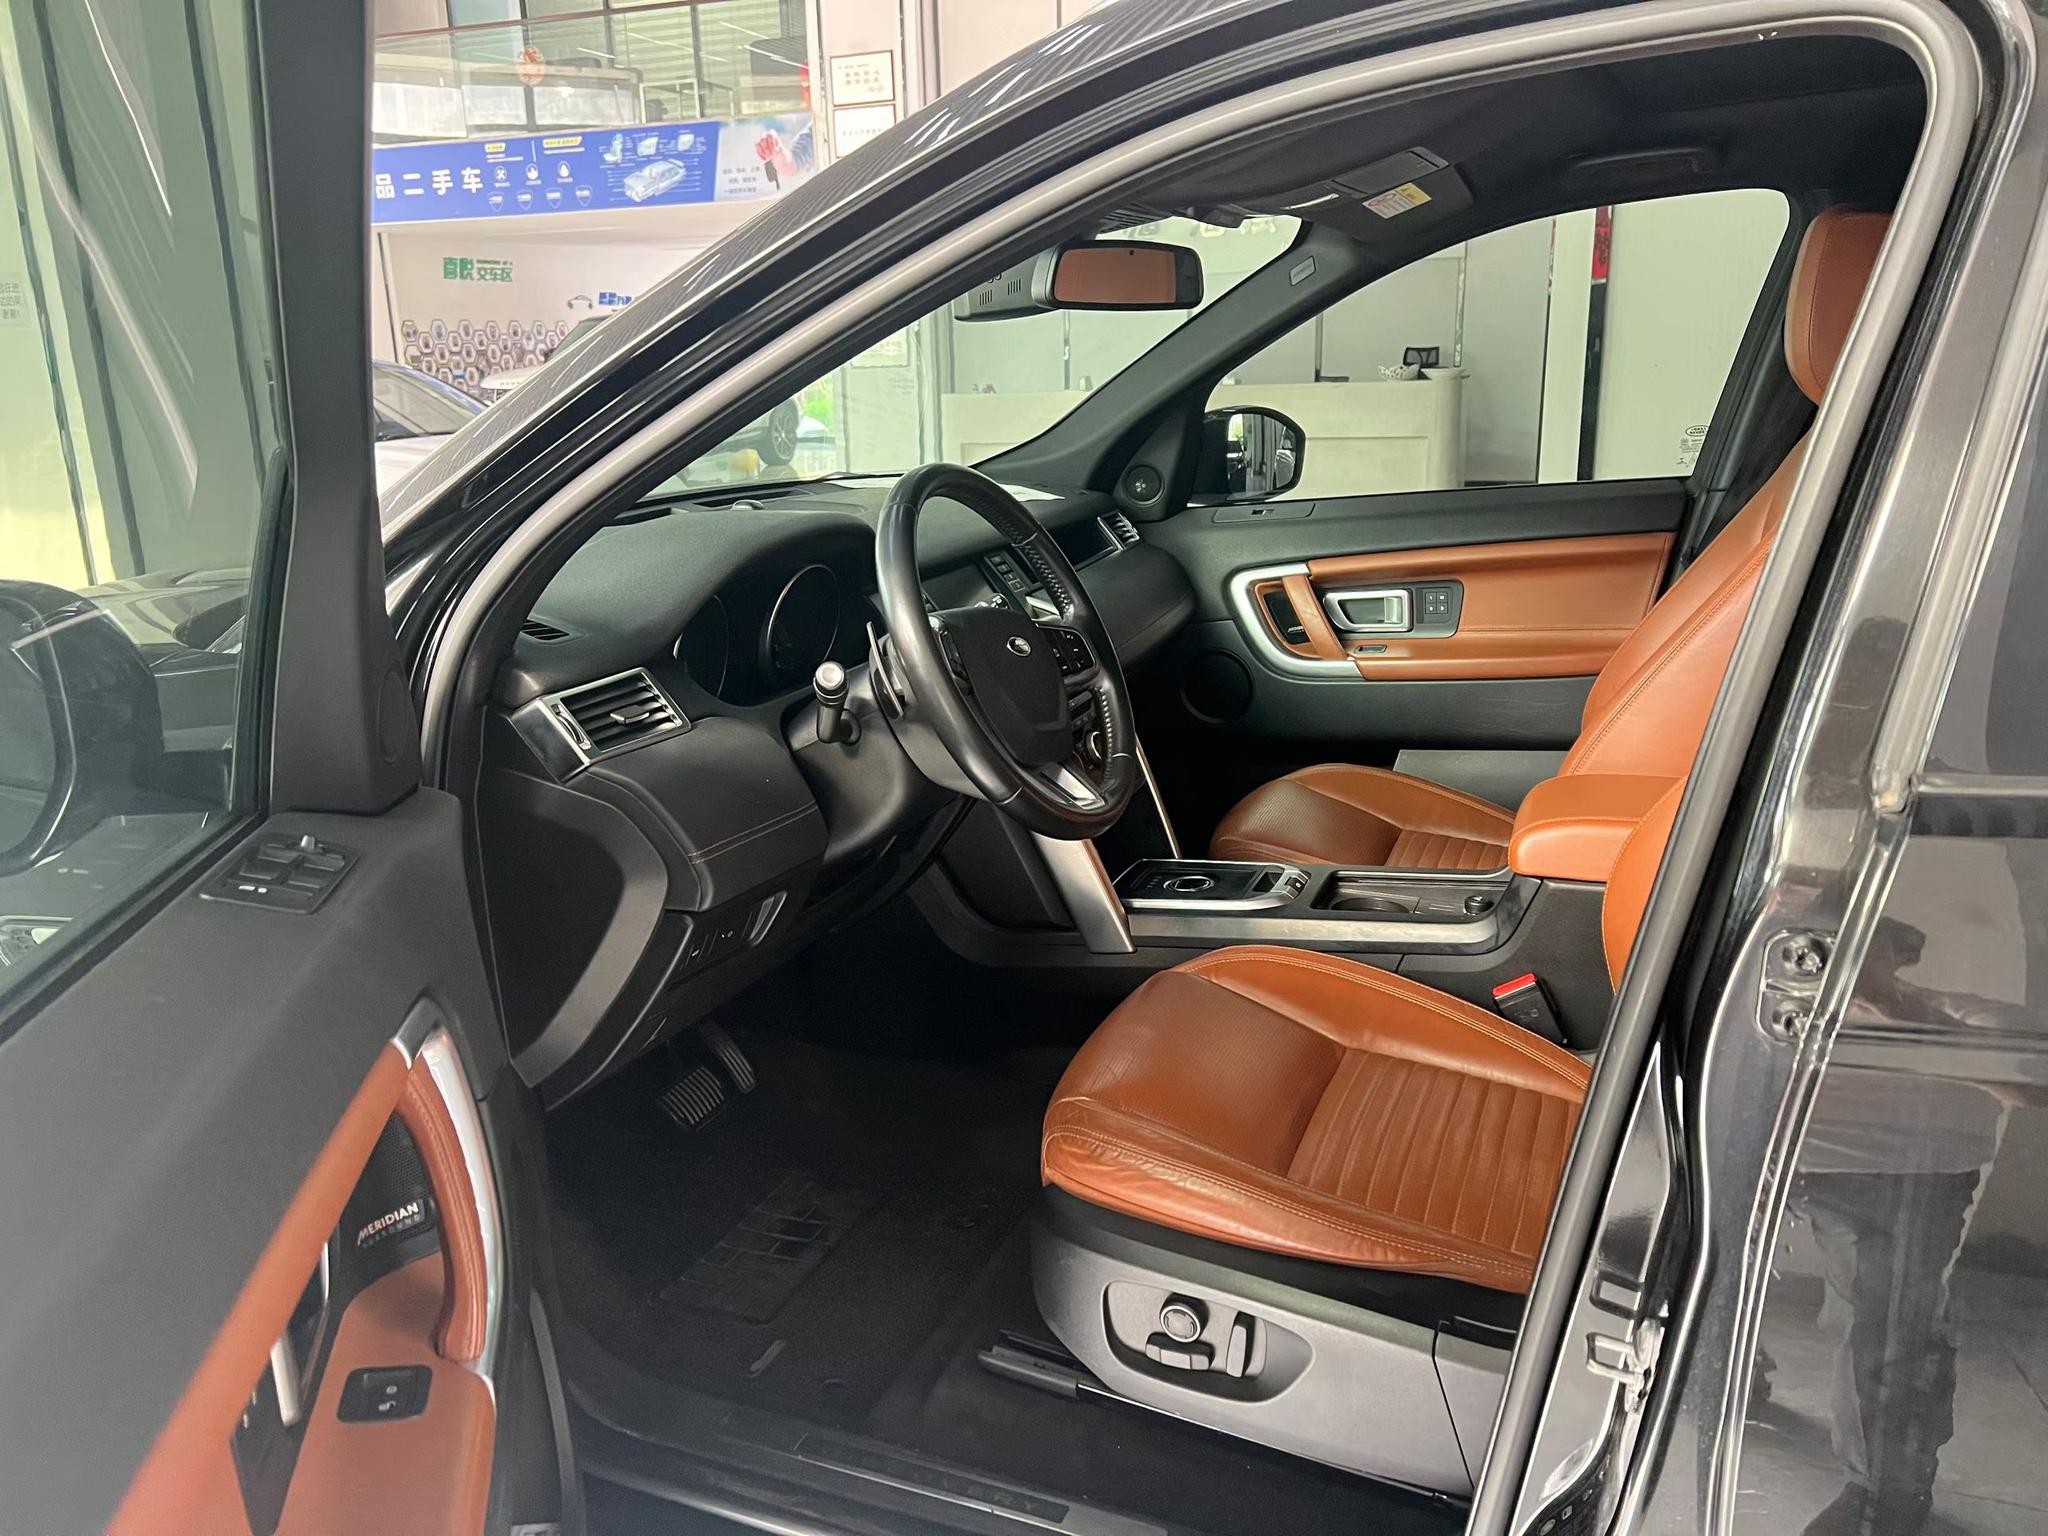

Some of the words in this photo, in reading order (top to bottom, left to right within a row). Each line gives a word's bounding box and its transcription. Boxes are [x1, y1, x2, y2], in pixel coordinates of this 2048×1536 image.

[375, 166, 483, 199] 品二手车
[357, 1203, 419, 1246] MERIDIAN
